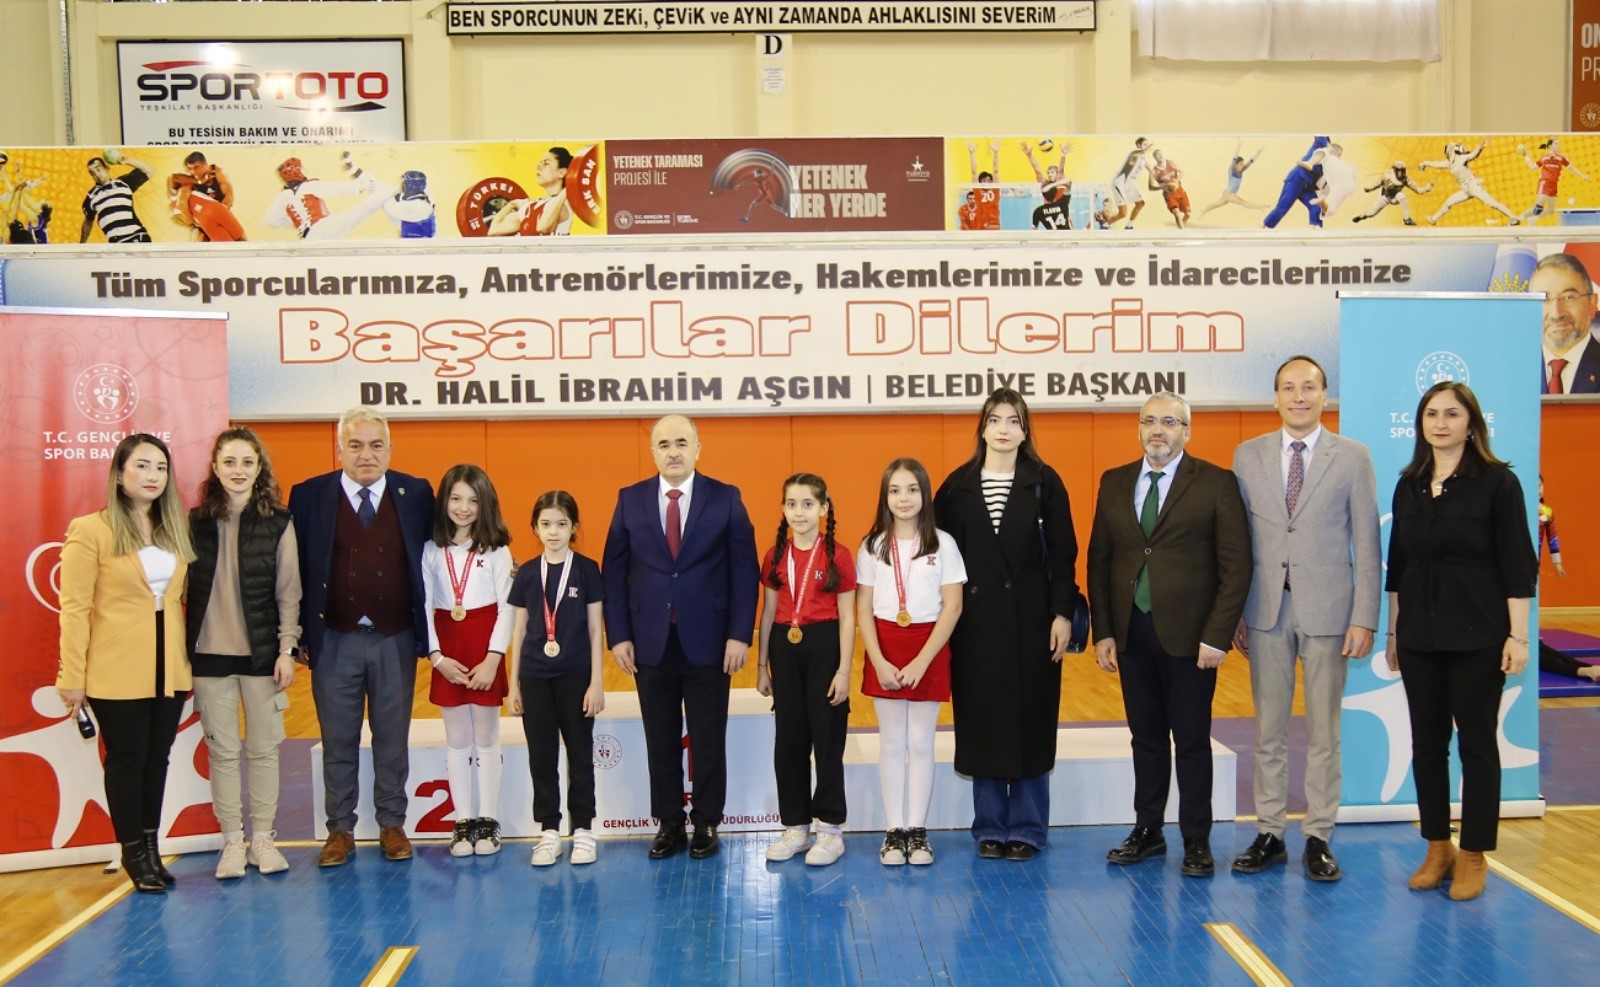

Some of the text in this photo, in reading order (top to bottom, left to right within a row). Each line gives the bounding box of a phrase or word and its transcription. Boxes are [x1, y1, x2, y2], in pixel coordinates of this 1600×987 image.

[450, 10, 485, 27] BEN
[491, 9, 598, 26] SPORCUNUN
[711, 11, 729, 24] ve
[733, 7, 773, 24] AYNI
[779, 7, 863, 24] ZAMANDA
[867, 6, 976, 24] AHLAKLISINI
[763, 35, 783, 54] D
[140, 104, 192, 112] TEŞKİLAT
[169, 128, 185, 137] BU
[189, 125, 235, 137] TESİSİN
[240, 127, 278, 137] BAKIM
[282, 127, 297, 136] VE
[613, 154, 703, 168] YETENEK TARAMASI
[614, 170, 667, 186] PROJESİ İLE
[789, 164, 868, 190] YETENEK
[790, 192, 887, 218] HER YERDE
[1045, 213, 1066, 230] 14
[91, 254, 1411, 304] Tüm Sporcularımıza, Antrenörlerimize, Hakemlerimize ve İdarecilerimize
[279, 297, 1244, 377] Başarılar Dilerim
[360, 368, 1186, 407] DR. HALİL İBRAHİM AŞGIN BELEDİYE BAŞKANI
[1390, 412, 1414, 423] T.C.
[43, 431, 72, 443] T.C.
[1390, 427, 1416, 438] SPO
[44, 448, 85, 459] SPOR
[476, 559, 484, 567] K
[926, 556, 936, 566] K
[814, 570, 823, 580] K
[568, 586, 578, 597] K
[414, 779, 456, 832] 2
[603, 817, 649, 830] GENÇLİK
[721, 813, 780, 825] ÜDÜRLÜĞÜ
